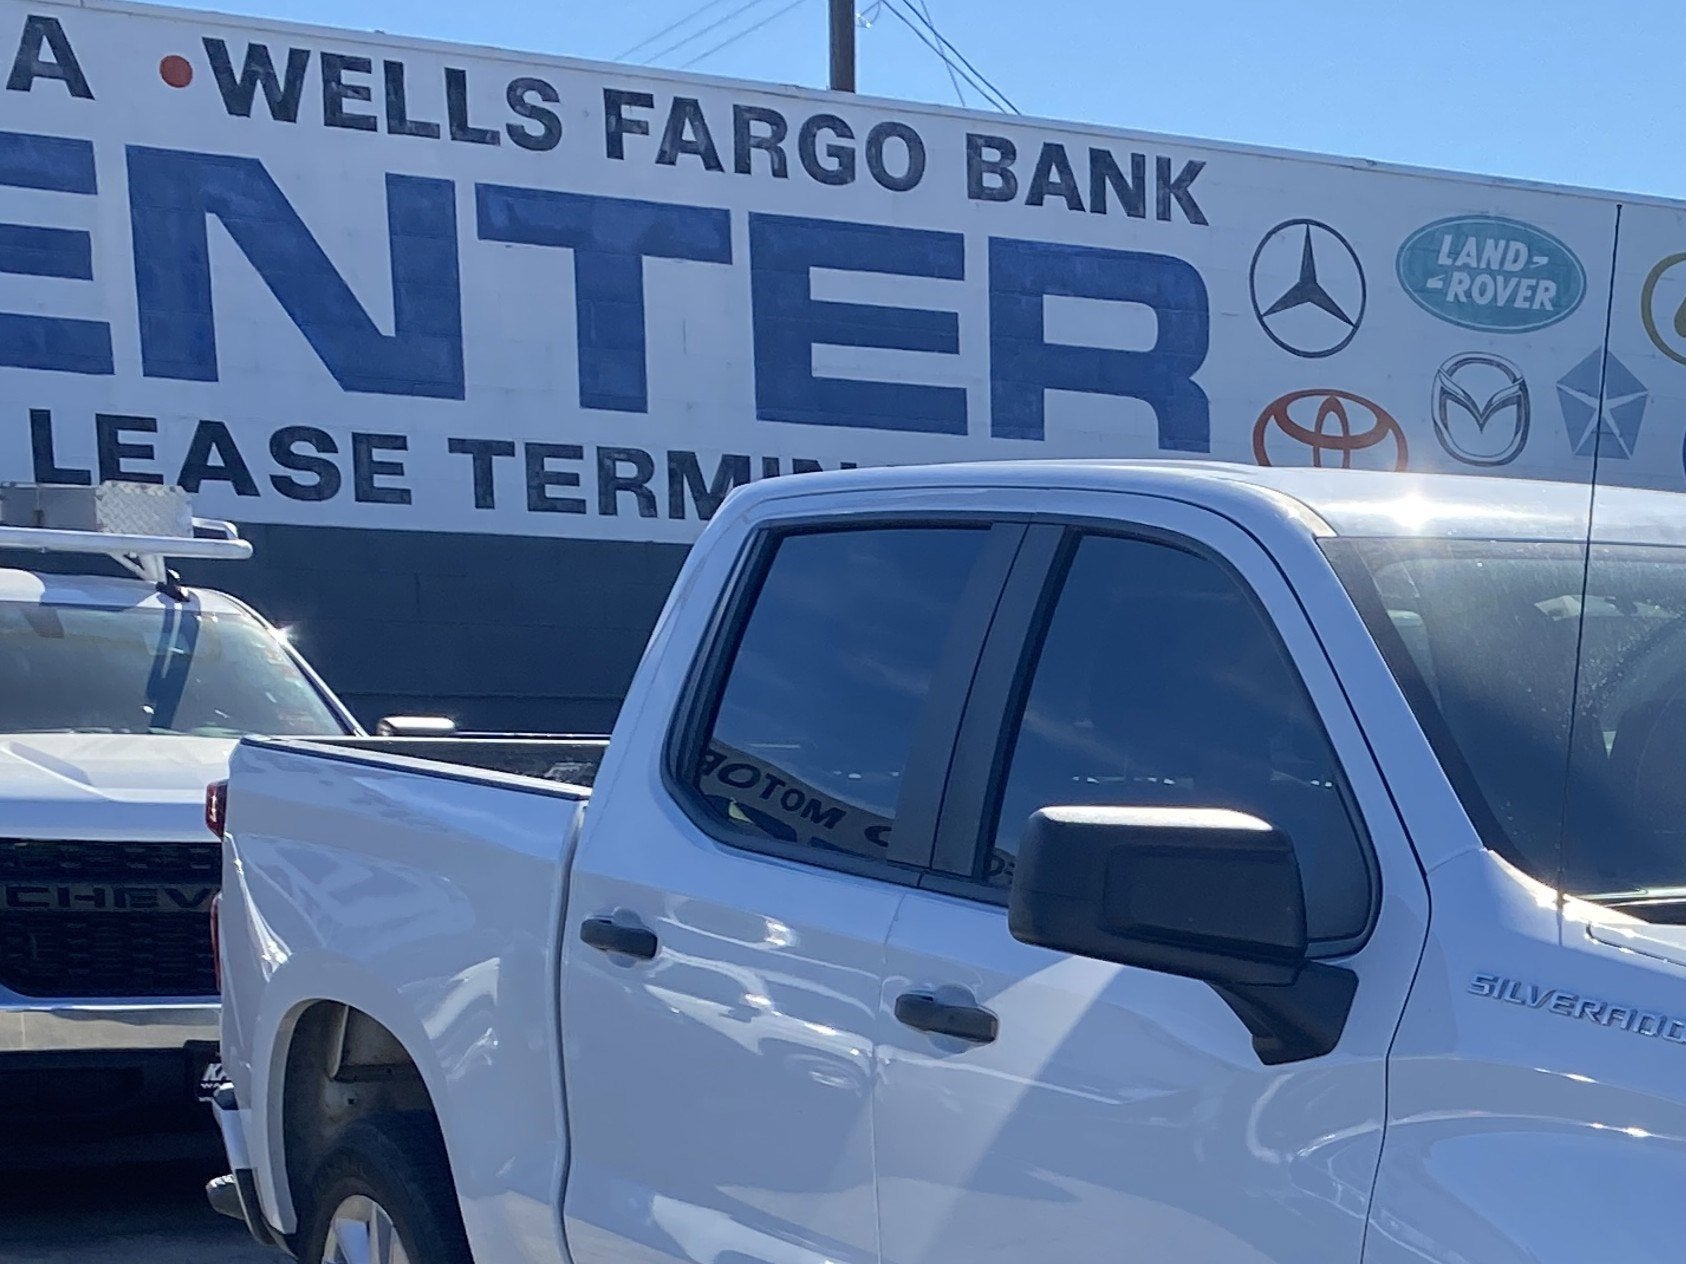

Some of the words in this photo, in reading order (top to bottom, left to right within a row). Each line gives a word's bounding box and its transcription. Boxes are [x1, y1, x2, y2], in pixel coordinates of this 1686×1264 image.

[202, 37, 562, 151] WELLS
[603, 87, 926, 191] FARGO
[966, 132, 1209, 225] BANK
[29, 408, 411, 505] LEASE
[448, 437, 857, 519] TERM
